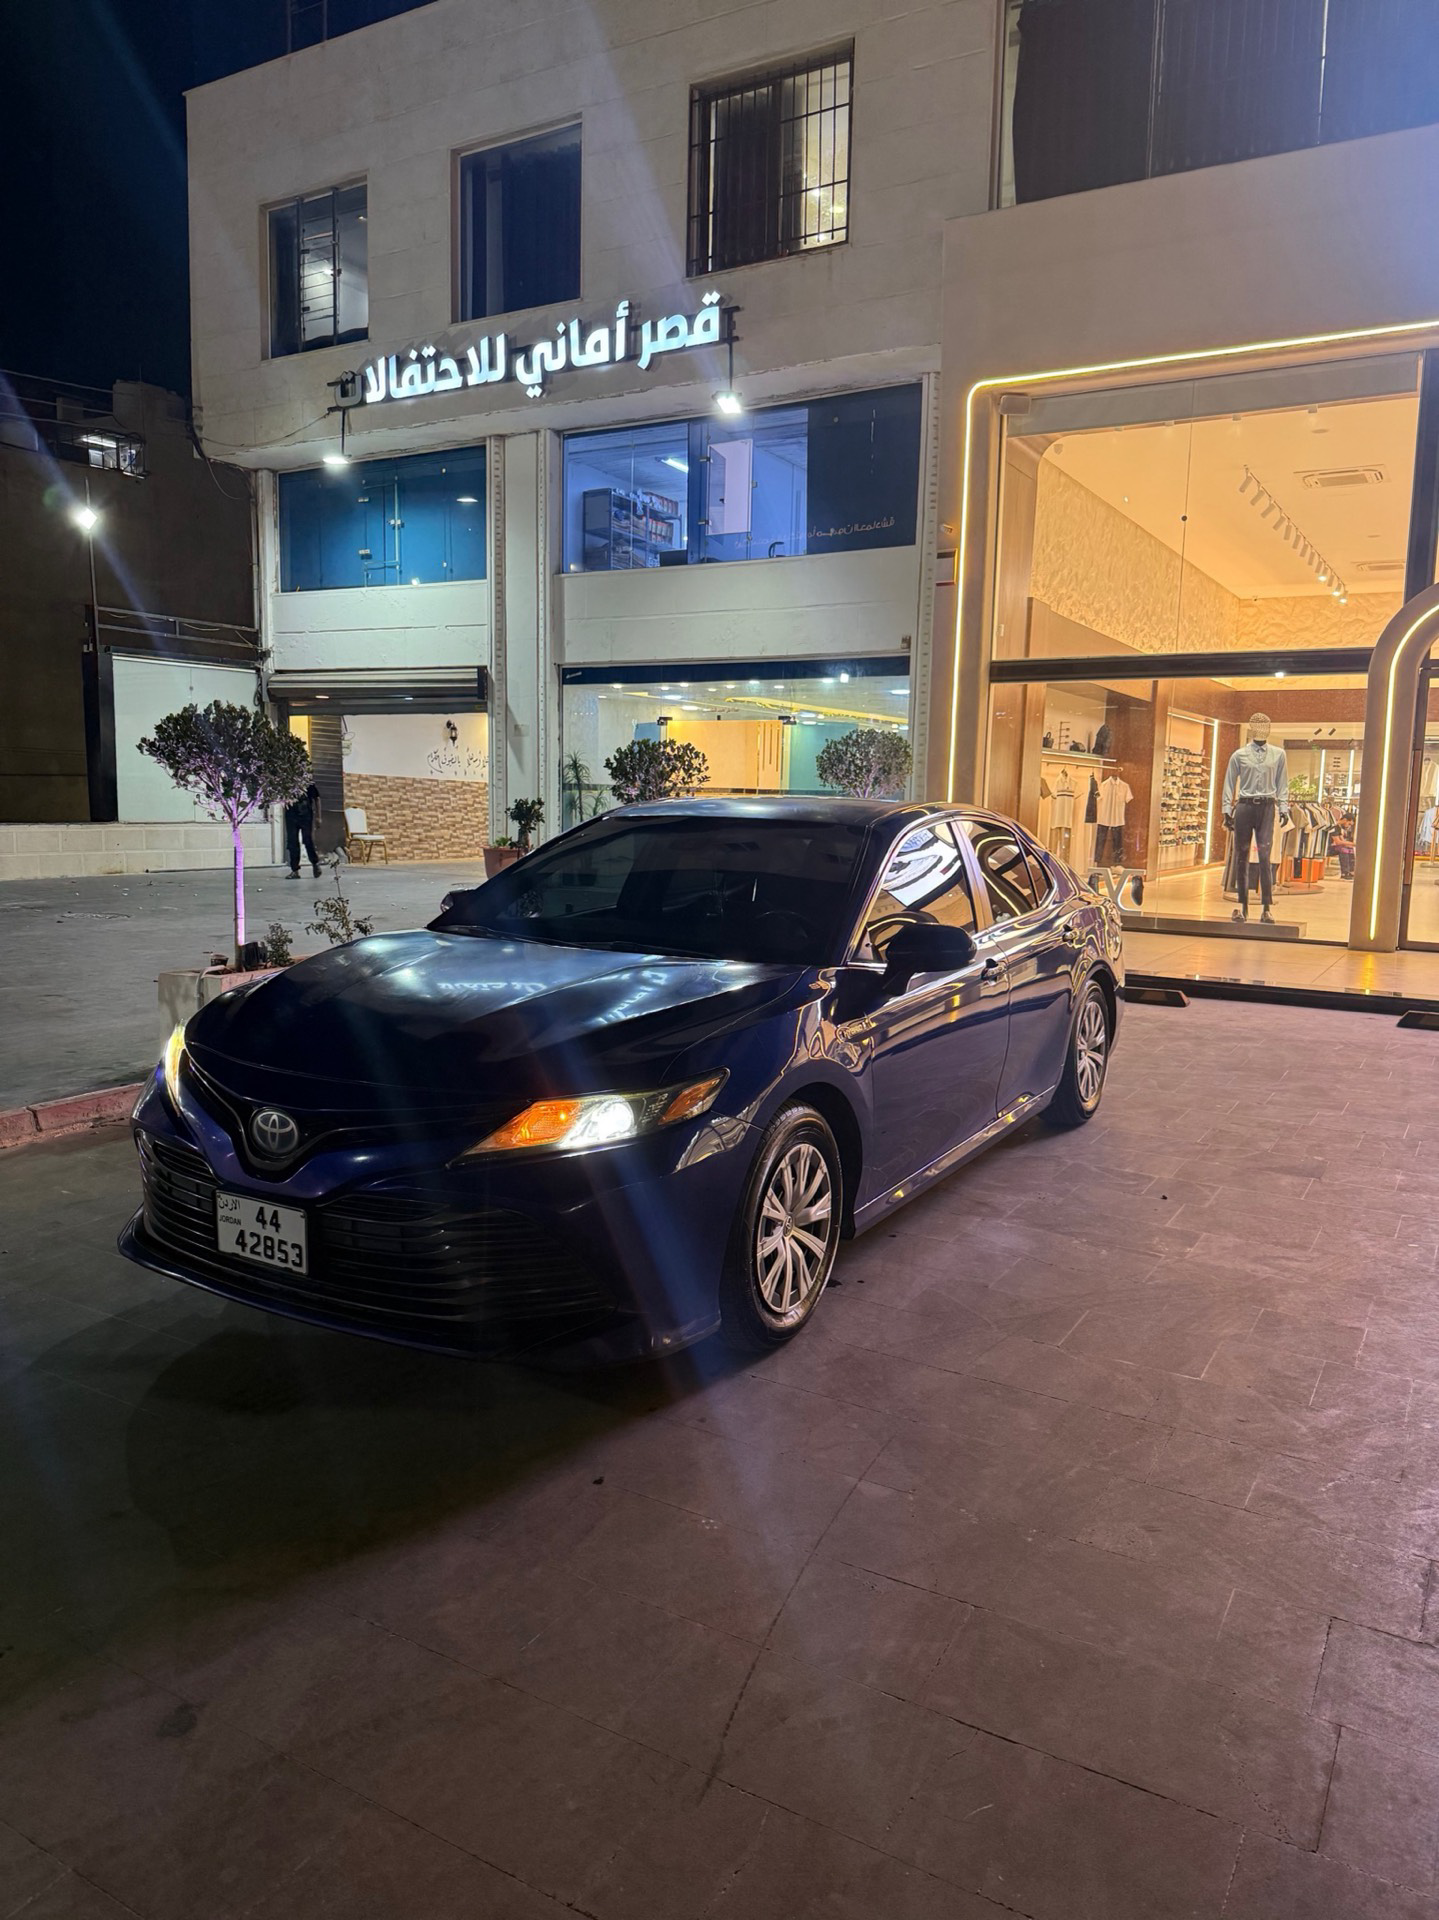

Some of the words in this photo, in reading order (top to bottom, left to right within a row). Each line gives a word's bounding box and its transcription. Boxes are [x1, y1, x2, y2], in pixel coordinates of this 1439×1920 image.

[515, 300, 630, 398] أماني
[637, 291, 721, 370] قصر
[333, 332, 506, 408] للاحتفالات
[219, 1215, 242, 1226] JORDAN
[255, 1206, 281, 1233] 44
[235, 1229, 303, 1268] 42853
